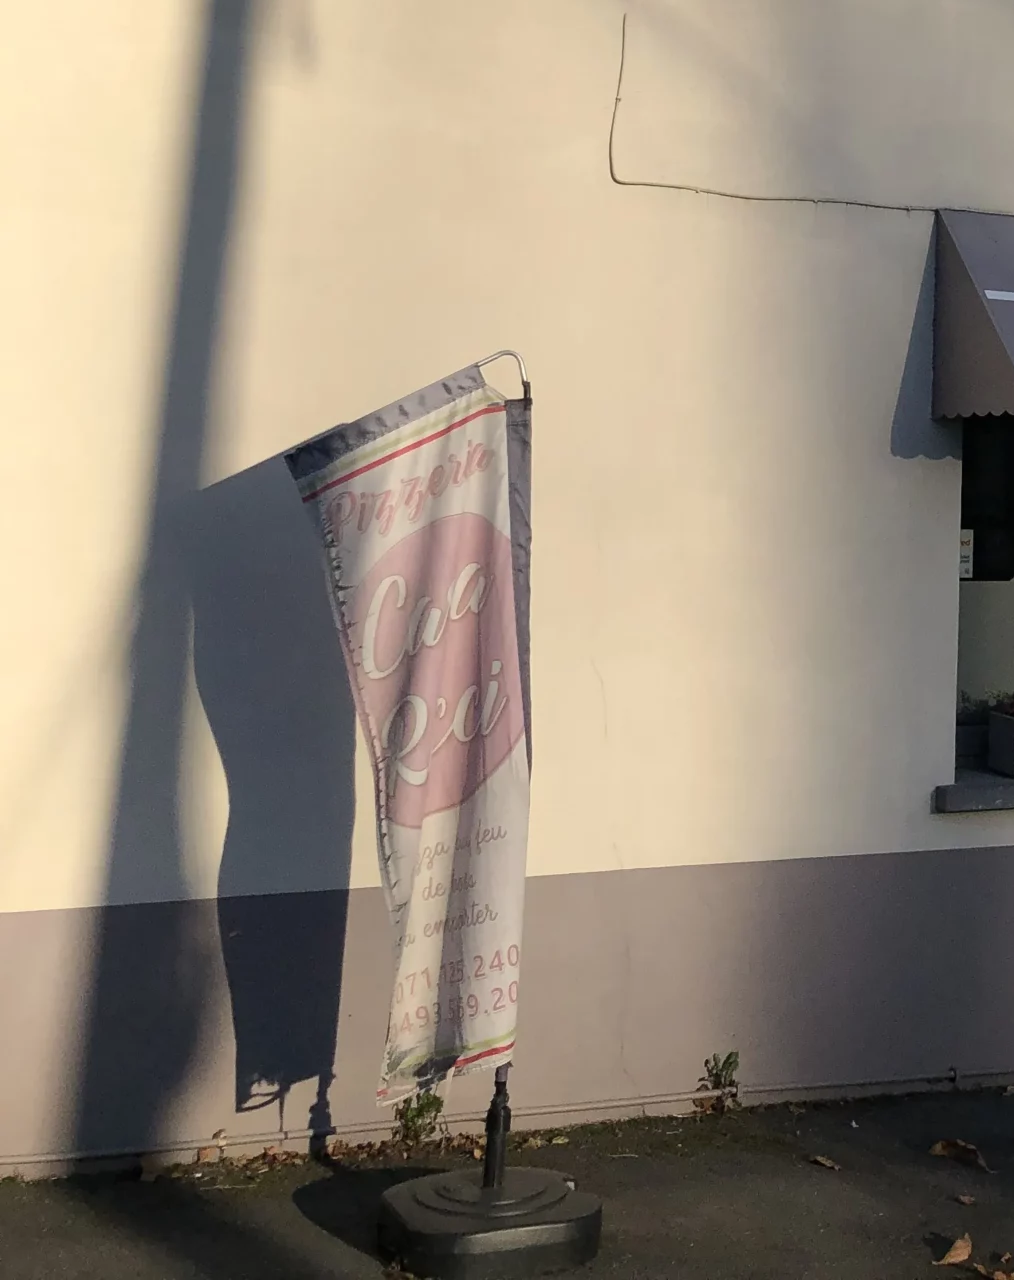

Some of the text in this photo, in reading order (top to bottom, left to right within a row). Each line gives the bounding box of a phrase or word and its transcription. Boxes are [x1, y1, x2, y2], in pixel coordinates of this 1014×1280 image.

[362, 563, 494, 680] Caa
[475, 818, 507, 855] feu
[422, 877, 447, 900] de
